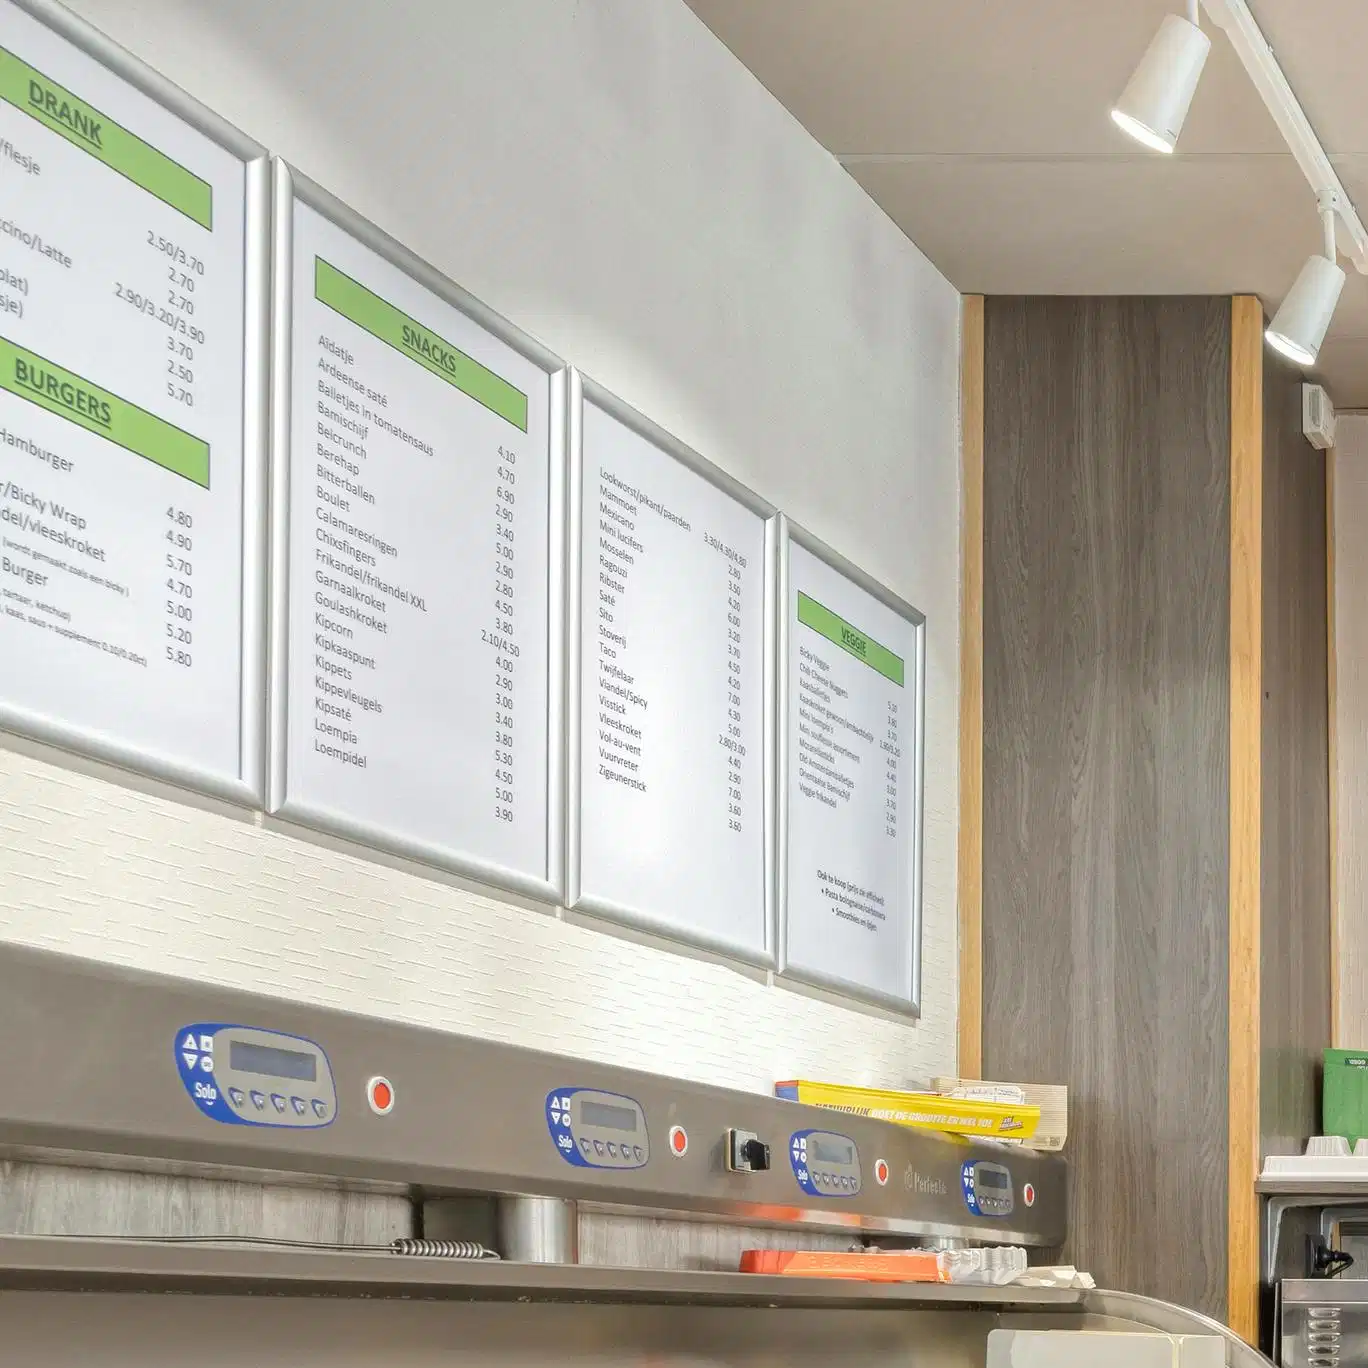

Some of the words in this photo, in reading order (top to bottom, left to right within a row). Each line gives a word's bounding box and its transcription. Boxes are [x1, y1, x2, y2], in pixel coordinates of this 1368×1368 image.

[28, 79, 103, 146] DRANK
[147, 230, 204, 275] 2.50/3.70
[168, 267, 194, 292] 2.70
[168, 290, 194, 315] 2.70
[167, 336, 193, 360] 3.70
[402, 325, 456, 375] SNACKS
[167, 359, 193, 383] 2.50
[318, 357, 365, 395] Ardeense
[366, 387, 388, 408] saté
[15, 357, 112, 424] BURGERS
[167, 383, 193, 406] 5.70
[373, 413, 434, 457] tomatensaus
[317, 443, 360, 476] Berehap
[316, 464, 375, 504] Bitterballen
[316, 485, 350, 512] Boulet
[600, 485, 637, 516] Mammoet
[50, 501, 87, 530] Wrap
[166, 507, 192, 528] 4.80
[600, 502, 635, 531] Mexicano
[600, 520, 616, 537] Mini
[166, 530, 192, 551] 4.90
[316, 507, 398, 558] Calamaresringen
[600, 537, 634, 565] Mosselen
[2, 556, 48, 586] Burger
[166, 554, 192, 576] 5.70
[166, 578, 192, 599] 4.70
[315, 548, 409, 604] Frikandel/frikandel
[410, 592, 428, 612] XXL
[166, 600, 192, 621] 5.00
[315, 591, 387, 634] Goulashkroket
[166, 623, 192, 644] 5.20
[315, 612, 353, 639] Kipcorn
[599, 624, 627, 649] Stoverij
[166, 646, 192, 667] 5.80
[315, 633, 376, 669] Kipkaaspunt
[599, 642, 617, 659] Taco
[315, 654, 352, 680] Kippets
[599, 659, 635, 684] Twijfelaar
[315, 675, 383, 713] Kippevleugels
[315, 718, 357, 744] Loempia
[599, 712, 642, 739] Vleeskroket
[315, 739, 367, 768] Loempidel
[599, 764, 647, 792] Zigeunerstick
[195, 1082, 217, 1101] Solo
[557, 1134, 573, 1151] Solo
